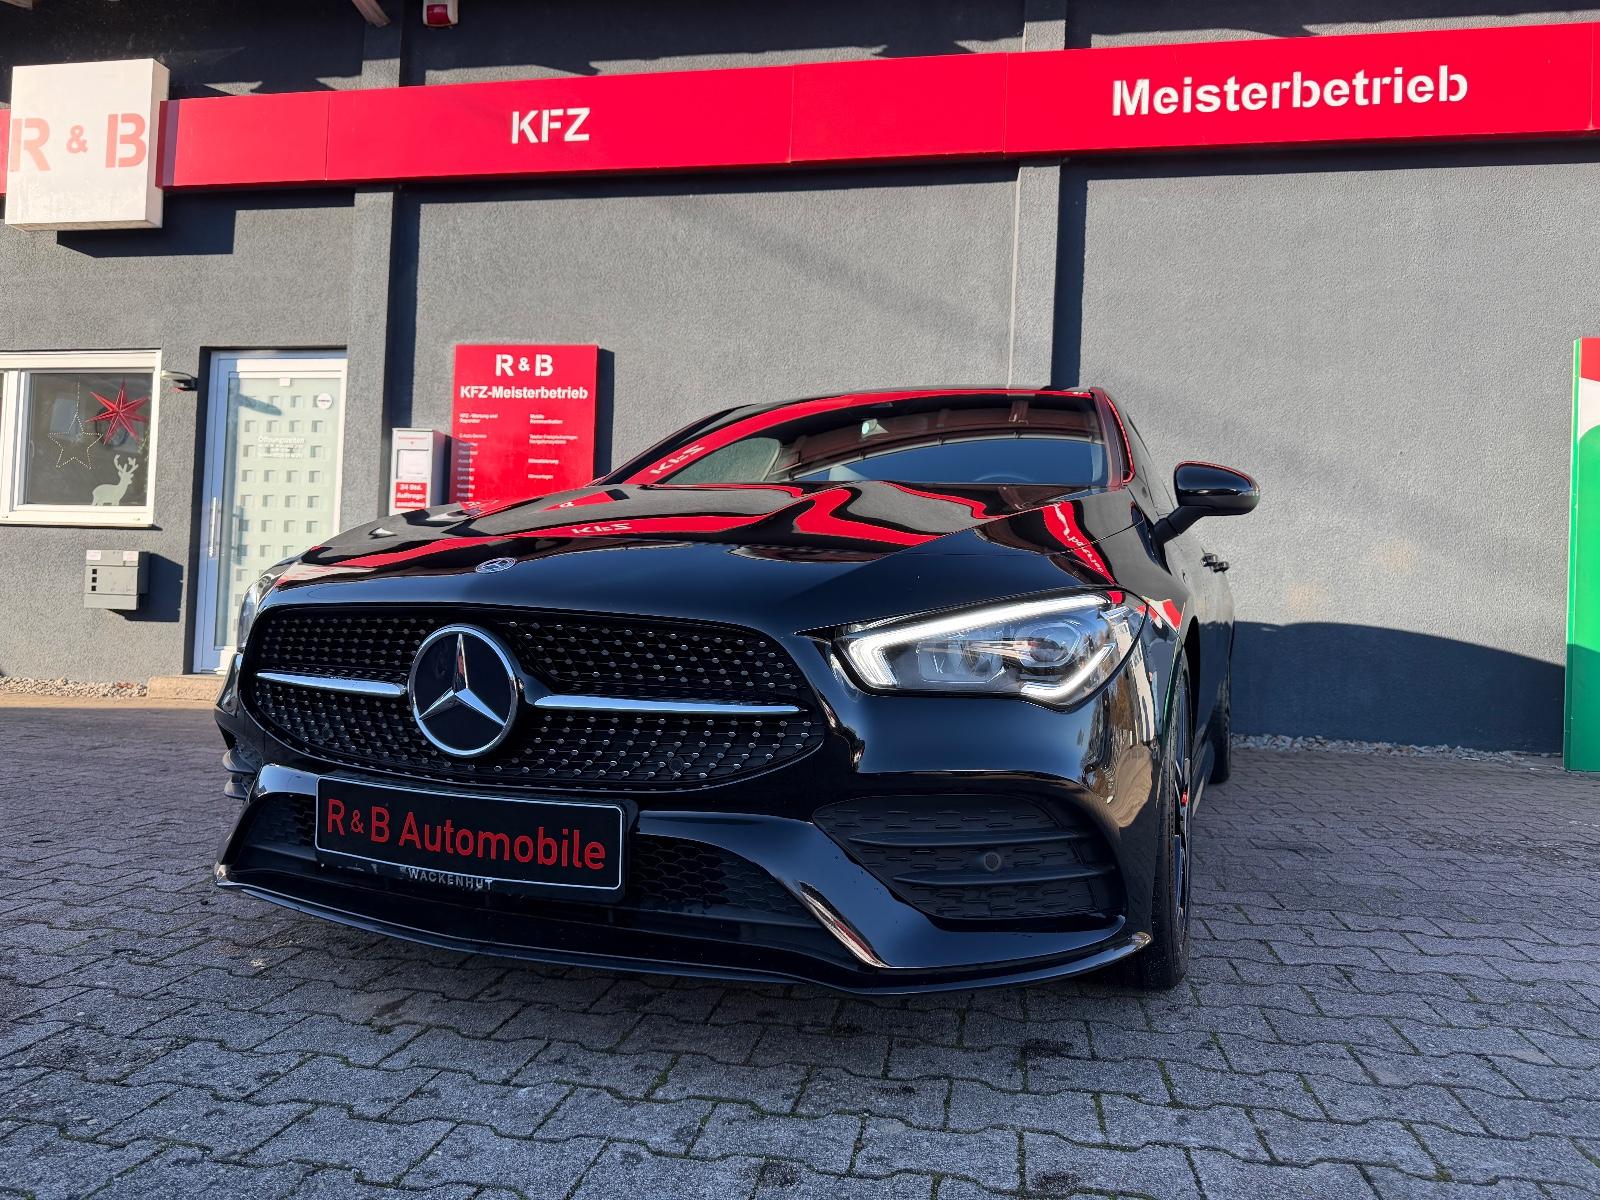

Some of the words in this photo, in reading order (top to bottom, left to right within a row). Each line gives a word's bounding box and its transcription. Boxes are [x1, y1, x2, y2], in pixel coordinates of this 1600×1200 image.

[1112, 65, 1468, 116] Meisterbetrieb
[9, 118, 51, 172] R
[66, 125, 89, 153] &
[105, 113, 147, 168] B
[511, 107, 591, 144] KFZ
[495, 354, 514, 376] R
[518, 357, 530, 371] &
[535, 354, 553, 376] B
[459, 385, 589, 399] KFZ-Meisterbetrieb
[327, 799, 345, 835] R
[350, 810, 364, 833] &
[370, 806, 390, 843] B
[399, 811, 606, 870] Automobile
[407, 866, 495, 890] WACKENHUT
